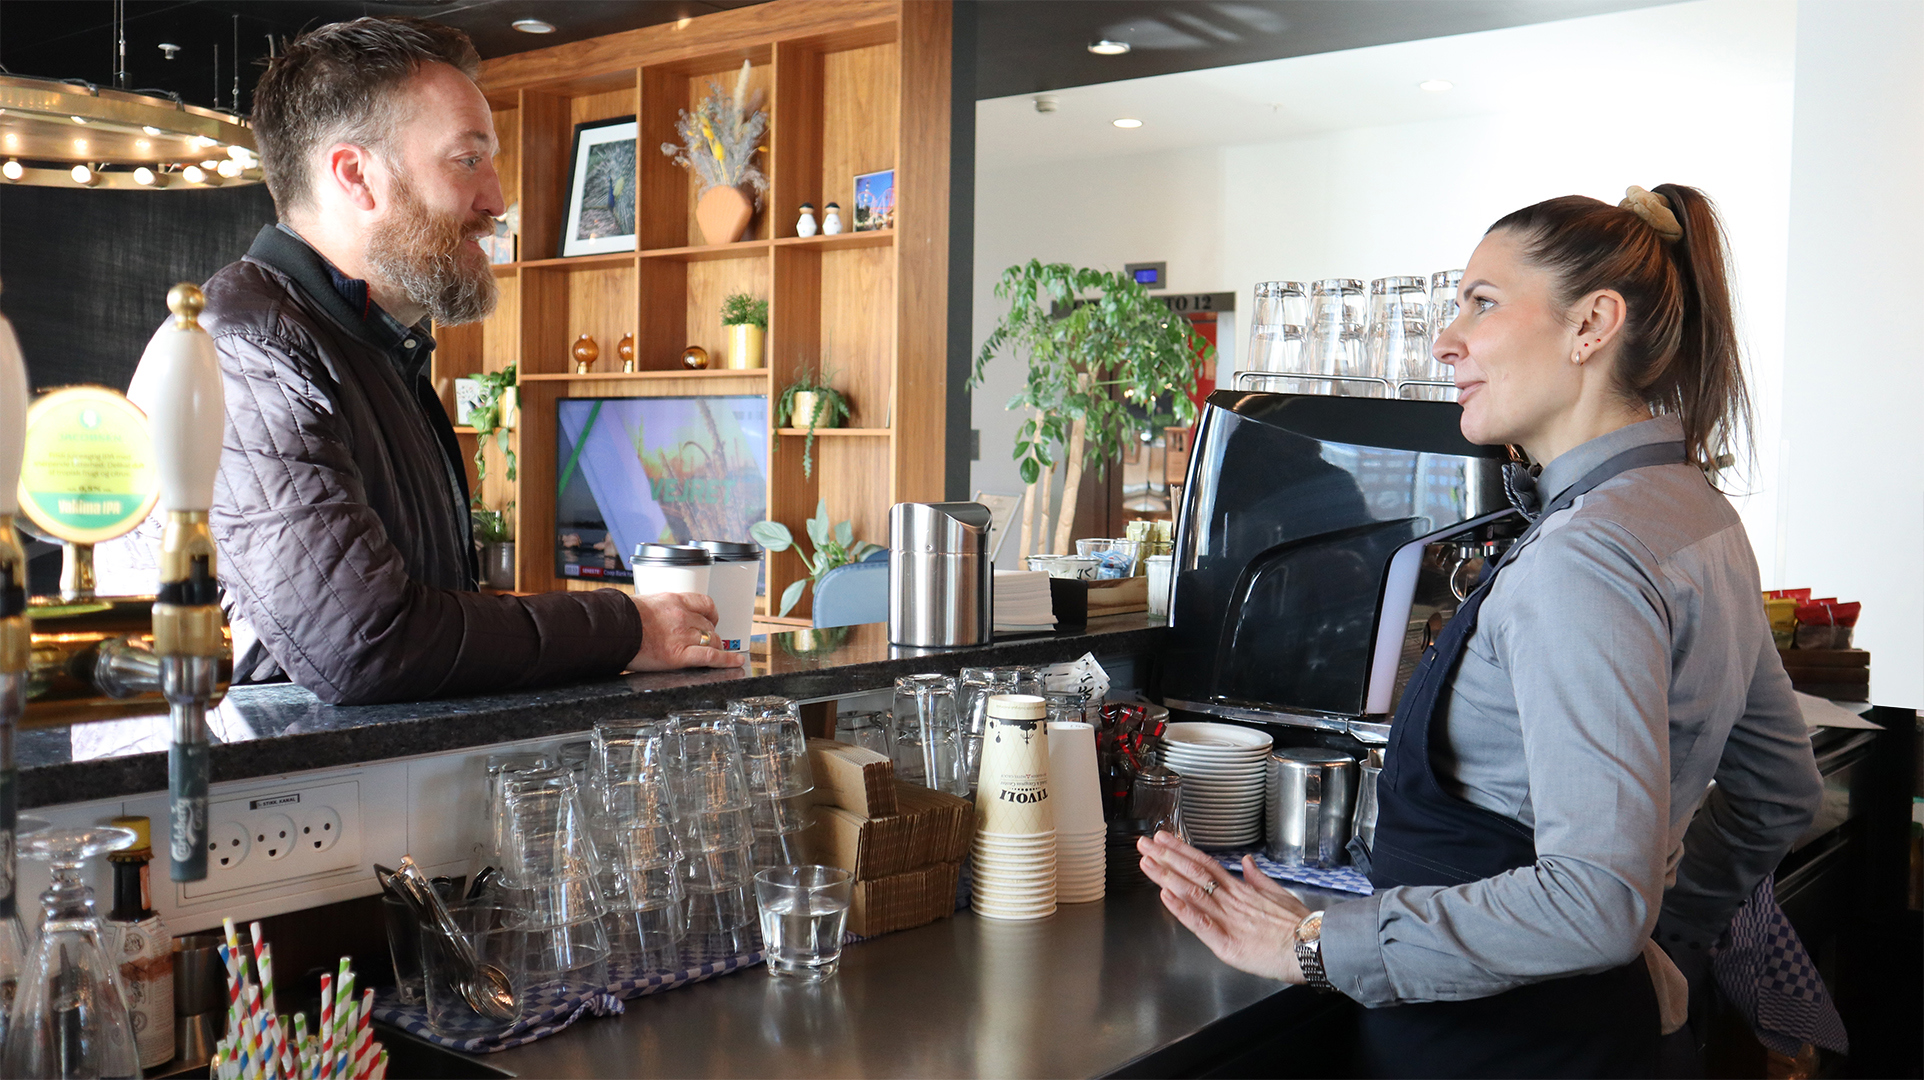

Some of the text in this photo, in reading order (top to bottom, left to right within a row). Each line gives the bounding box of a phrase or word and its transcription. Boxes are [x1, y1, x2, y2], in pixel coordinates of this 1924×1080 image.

[1166, 295, 1213, 311] TO 12
[650, 477, 736, 505] VEJRET
[58, 498, 121, 515] Yakima IPA
[999, 788, 1048, 804] TIVOLI
[171, 798, 191, 862] Carlsberg
